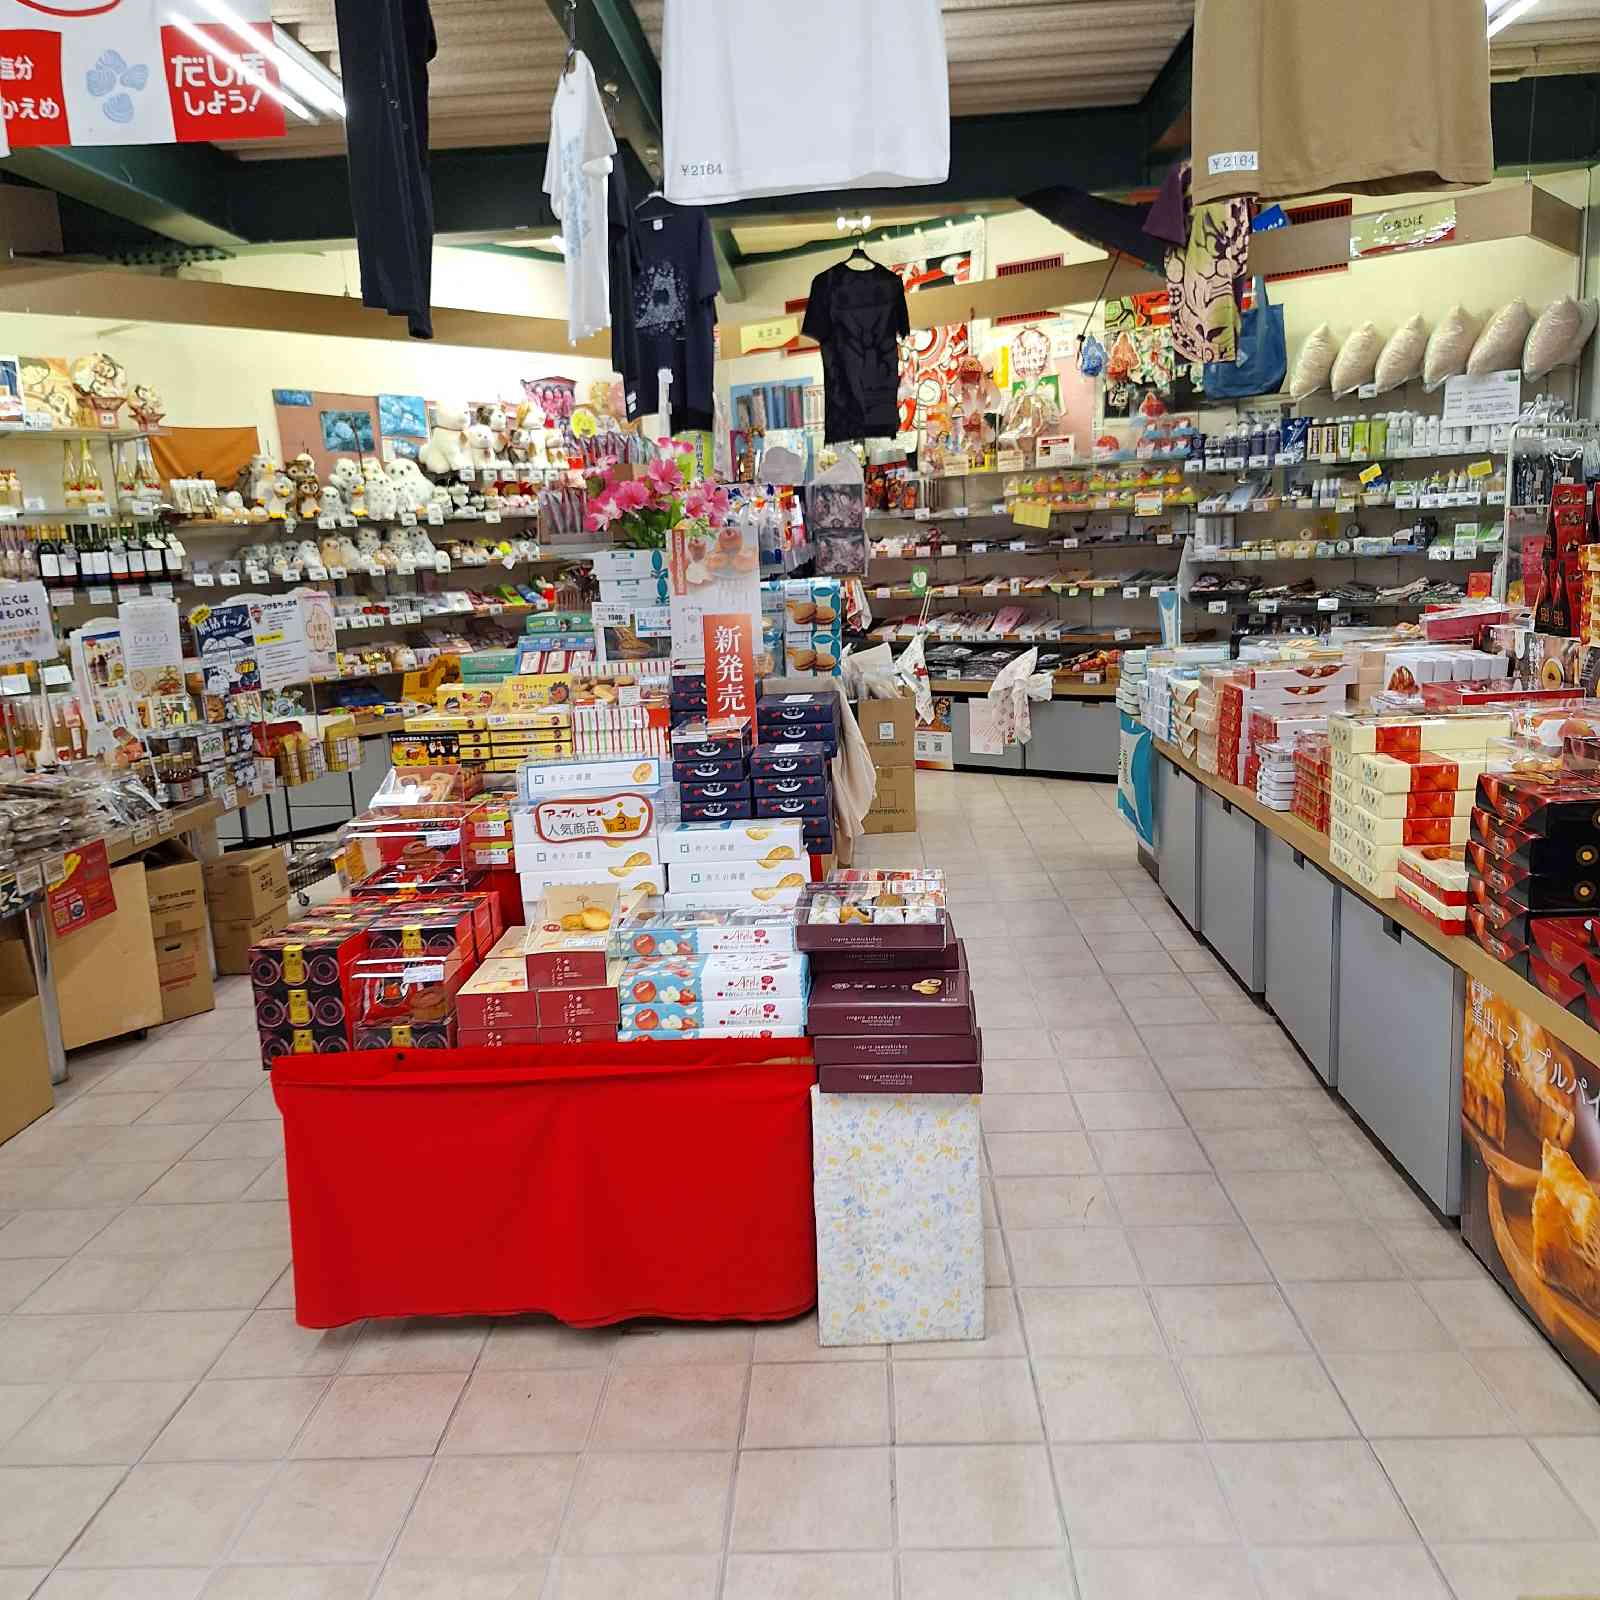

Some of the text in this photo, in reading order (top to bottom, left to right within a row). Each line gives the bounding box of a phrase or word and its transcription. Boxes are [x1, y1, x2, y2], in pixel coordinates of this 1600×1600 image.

[715, 625, 746, 713] 新発売
[548, 820, 601, 838] 人気商品
